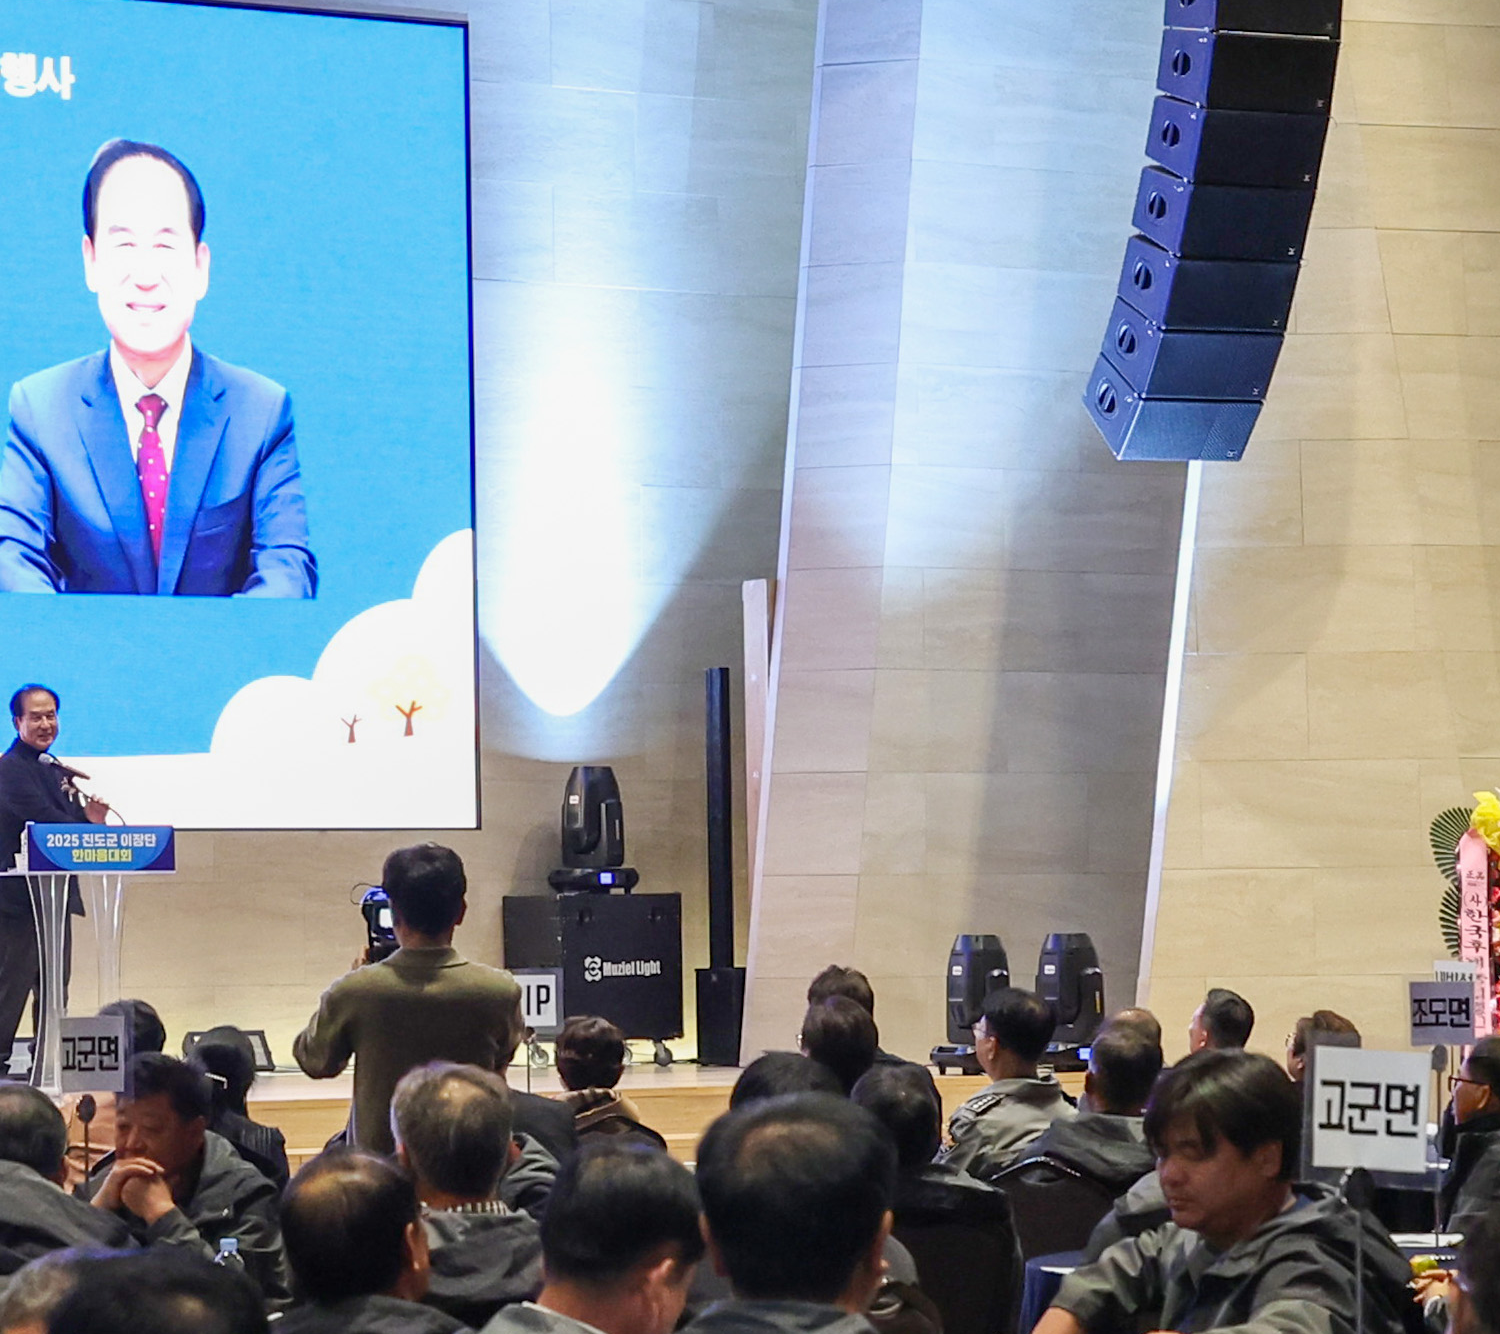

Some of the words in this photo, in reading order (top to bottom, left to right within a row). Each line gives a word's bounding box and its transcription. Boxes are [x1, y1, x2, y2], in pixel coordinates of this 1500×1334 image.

[46, 834, 79, 847] 2025
[82, 833, 118, 847] 진도군
[120, 833, 157, 847] 이장단
[603, 961, 635, 976] Muziel
[636, 960, 661, 977] Light
[524, 984, 550, 1016] IP
[62, 1035, 119, 1071] 고군면
[1319, 1078, 1421, 1139] 고군면
